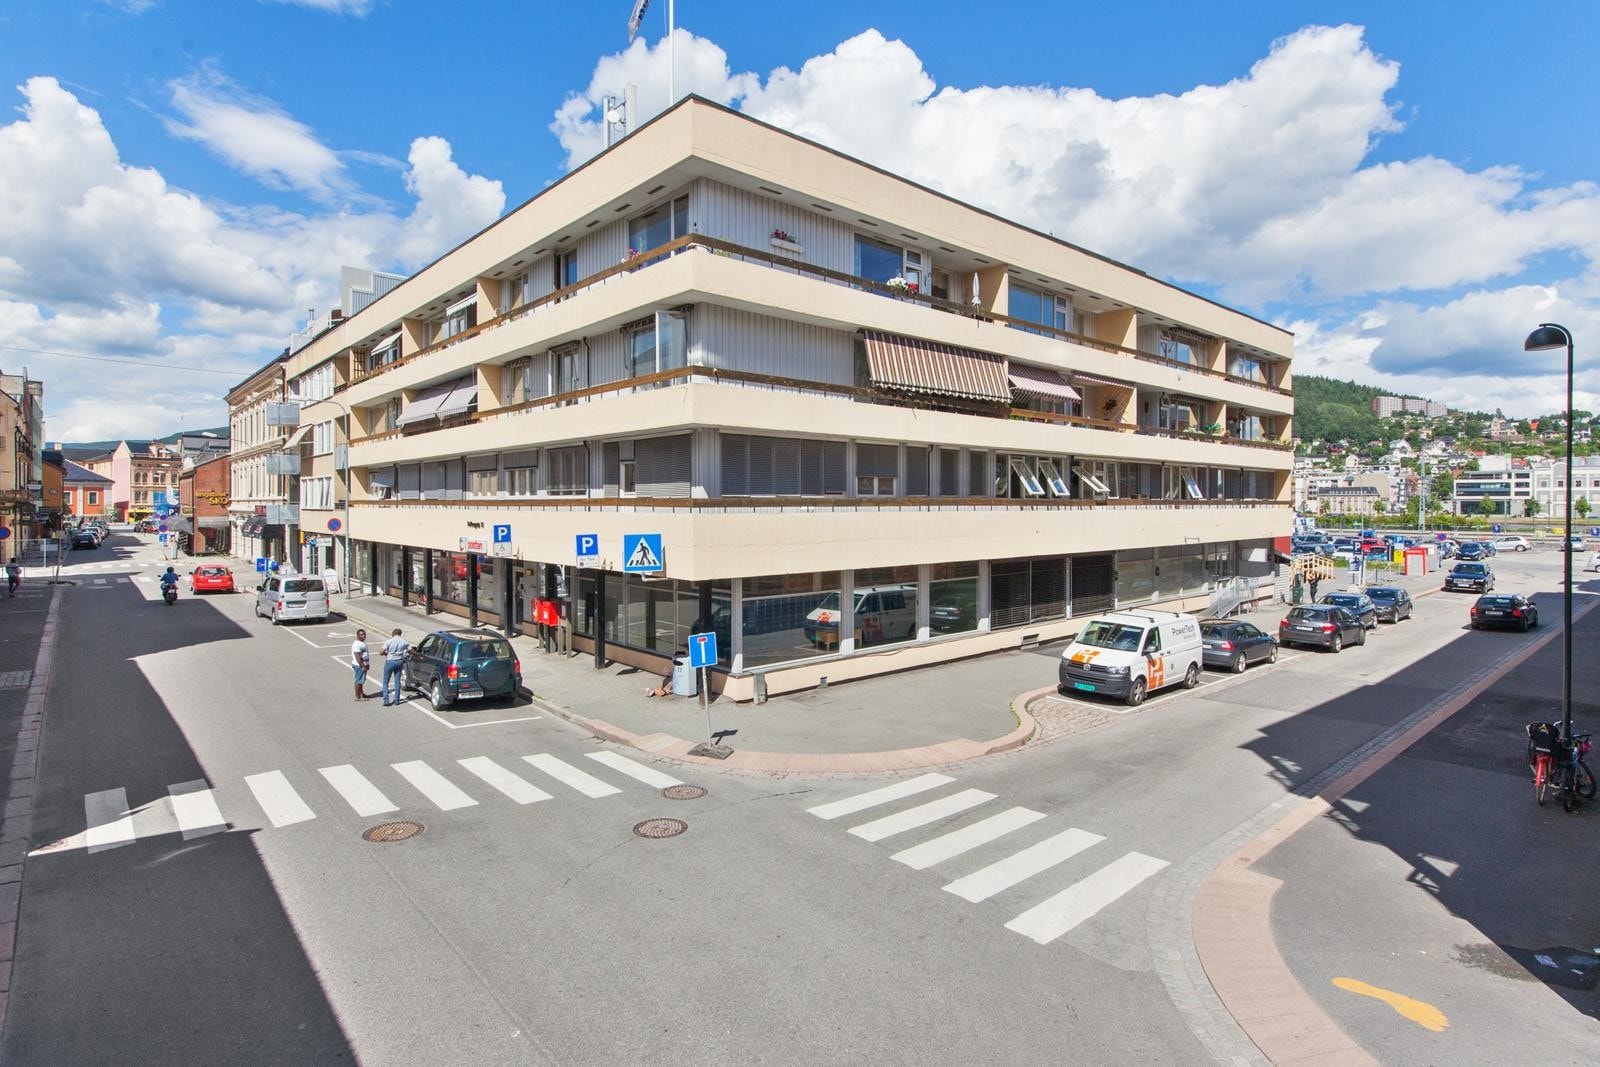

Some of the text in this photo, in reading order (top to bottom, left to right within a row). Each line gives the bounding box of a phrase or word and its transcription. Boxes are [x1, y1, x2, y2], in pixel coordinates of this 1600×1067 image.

[209, 497, 229, 505] SKO
[498, 526, 508, 541] P
[582, 536, 594, 554] P
[1171, 624, 1195, 636] PowerTech
